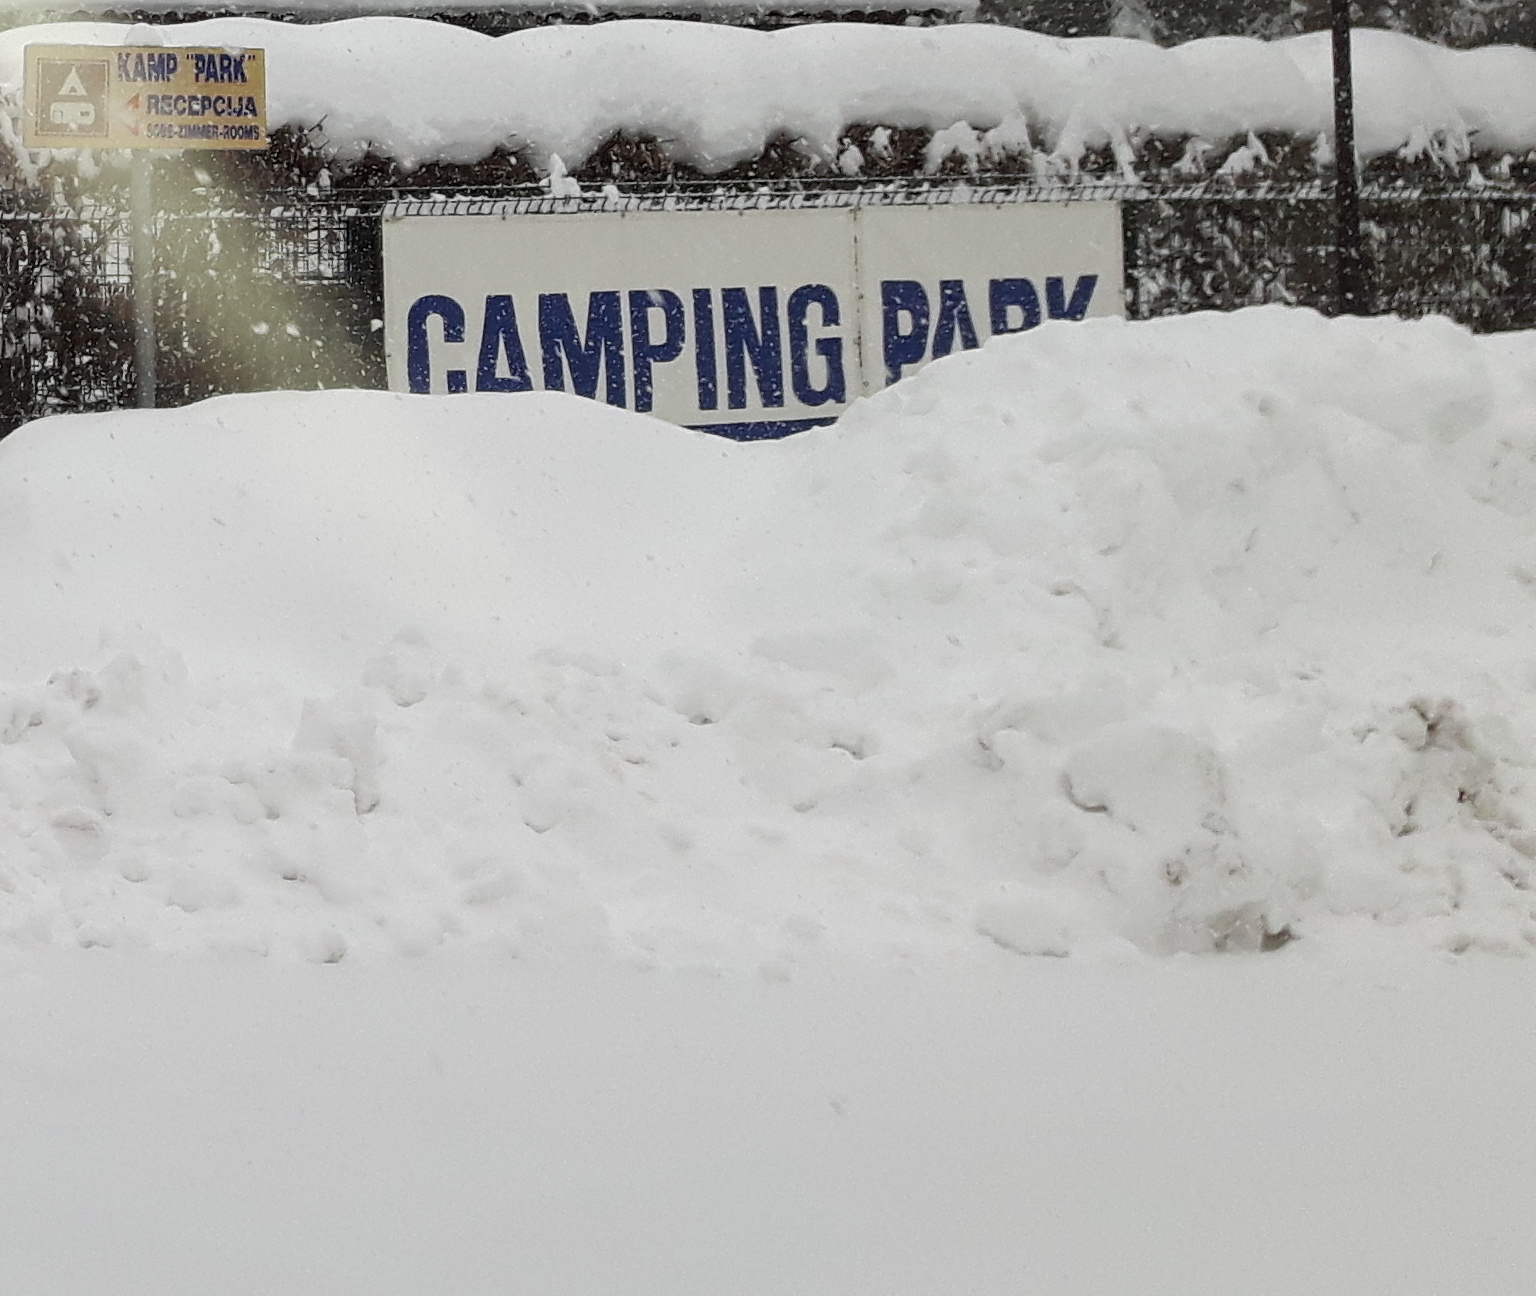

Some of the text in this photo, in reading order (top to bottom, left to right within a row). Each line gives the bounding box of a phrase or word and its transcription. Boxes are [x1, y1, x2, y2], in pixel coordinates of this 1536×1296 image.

[117, 52, 256, 84] KAMP "PARK"
[147, 94, 259, 118] RECEPCIJA
[406, 282, 847, 413] CAMPING
